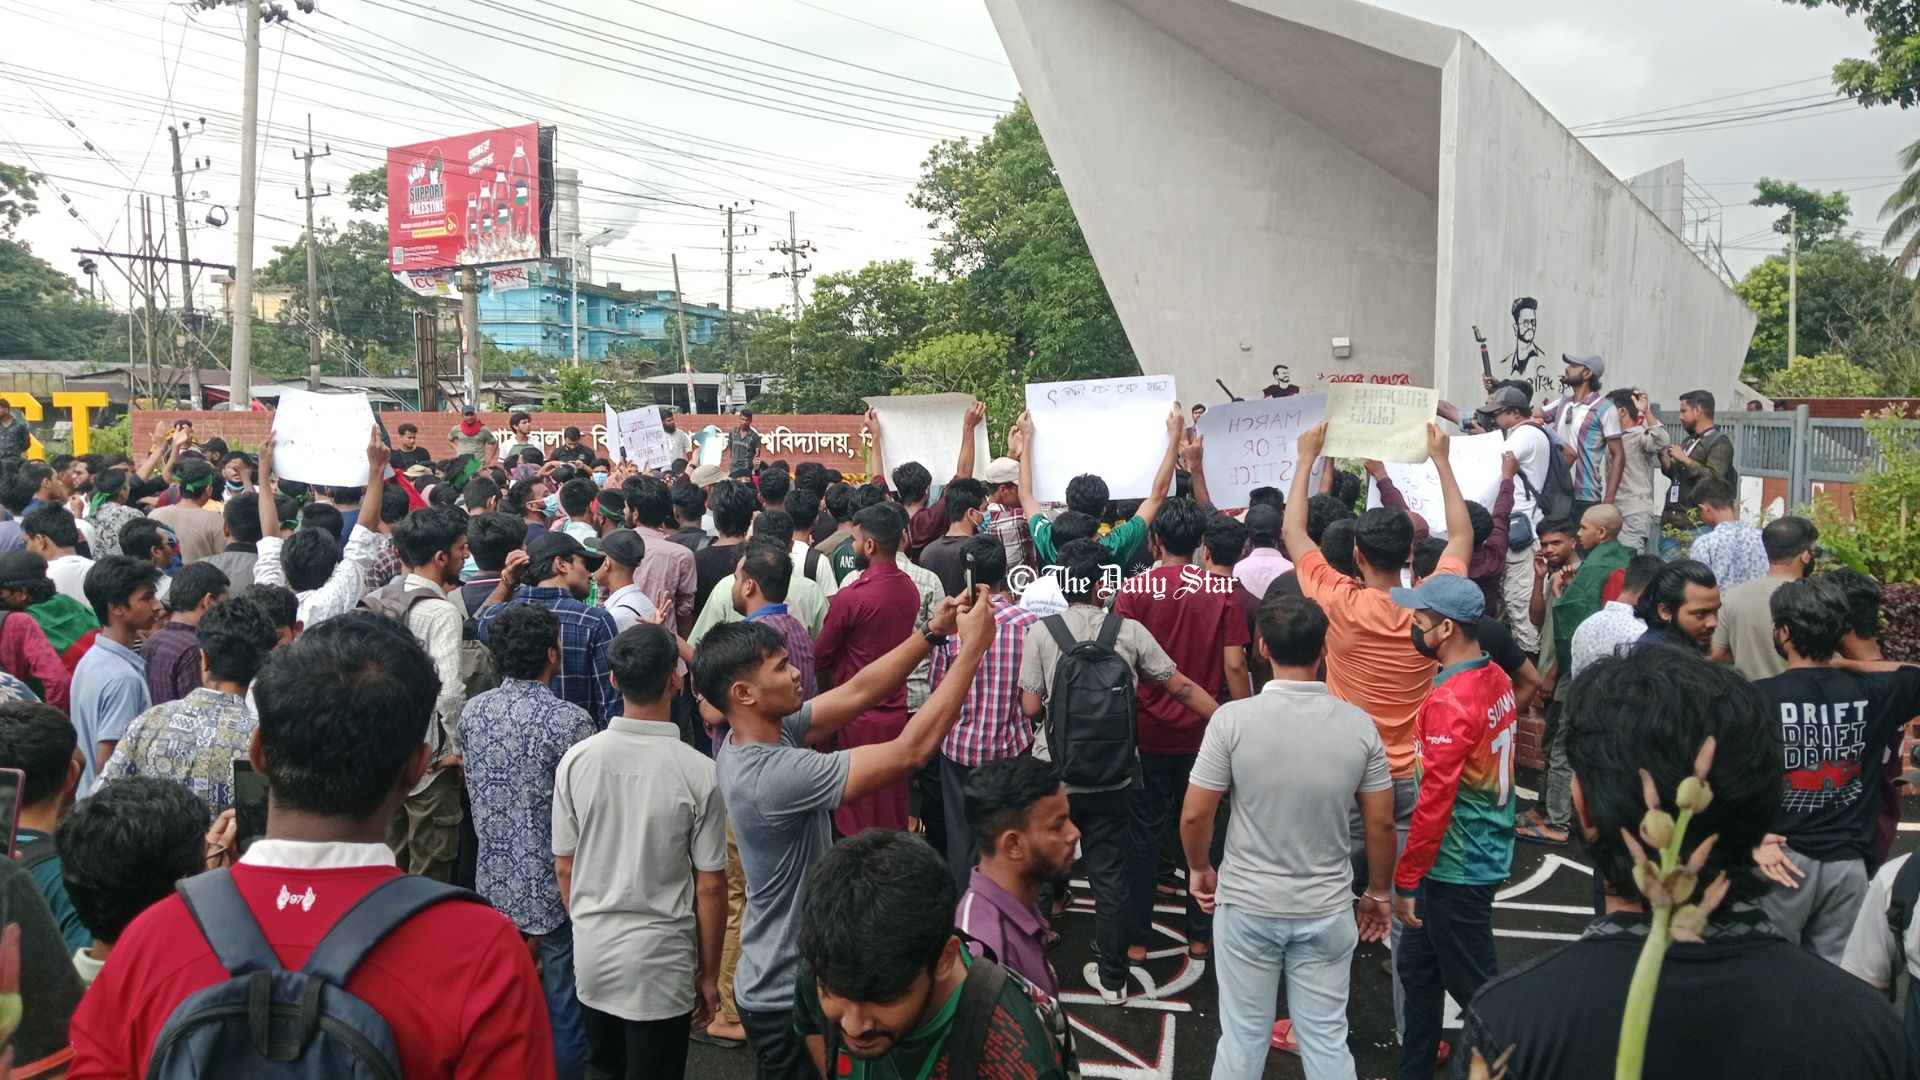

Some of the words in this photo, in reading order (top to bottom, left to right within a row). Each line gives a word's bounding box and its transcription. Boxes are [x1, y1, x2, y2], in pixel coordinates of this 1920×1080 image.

[409, 184, 444, 201] SUPPORT
[409, 200, 444, 216] PALESTINE
[839, 555, 856, 569] ANS
[1780, 700, 1869, 725] DRIFT
[1783, 721, 1867, 747] DRIFT
[1784, 743, 1866, 769] DRIFT
[289, 894, 304, 905] 97
